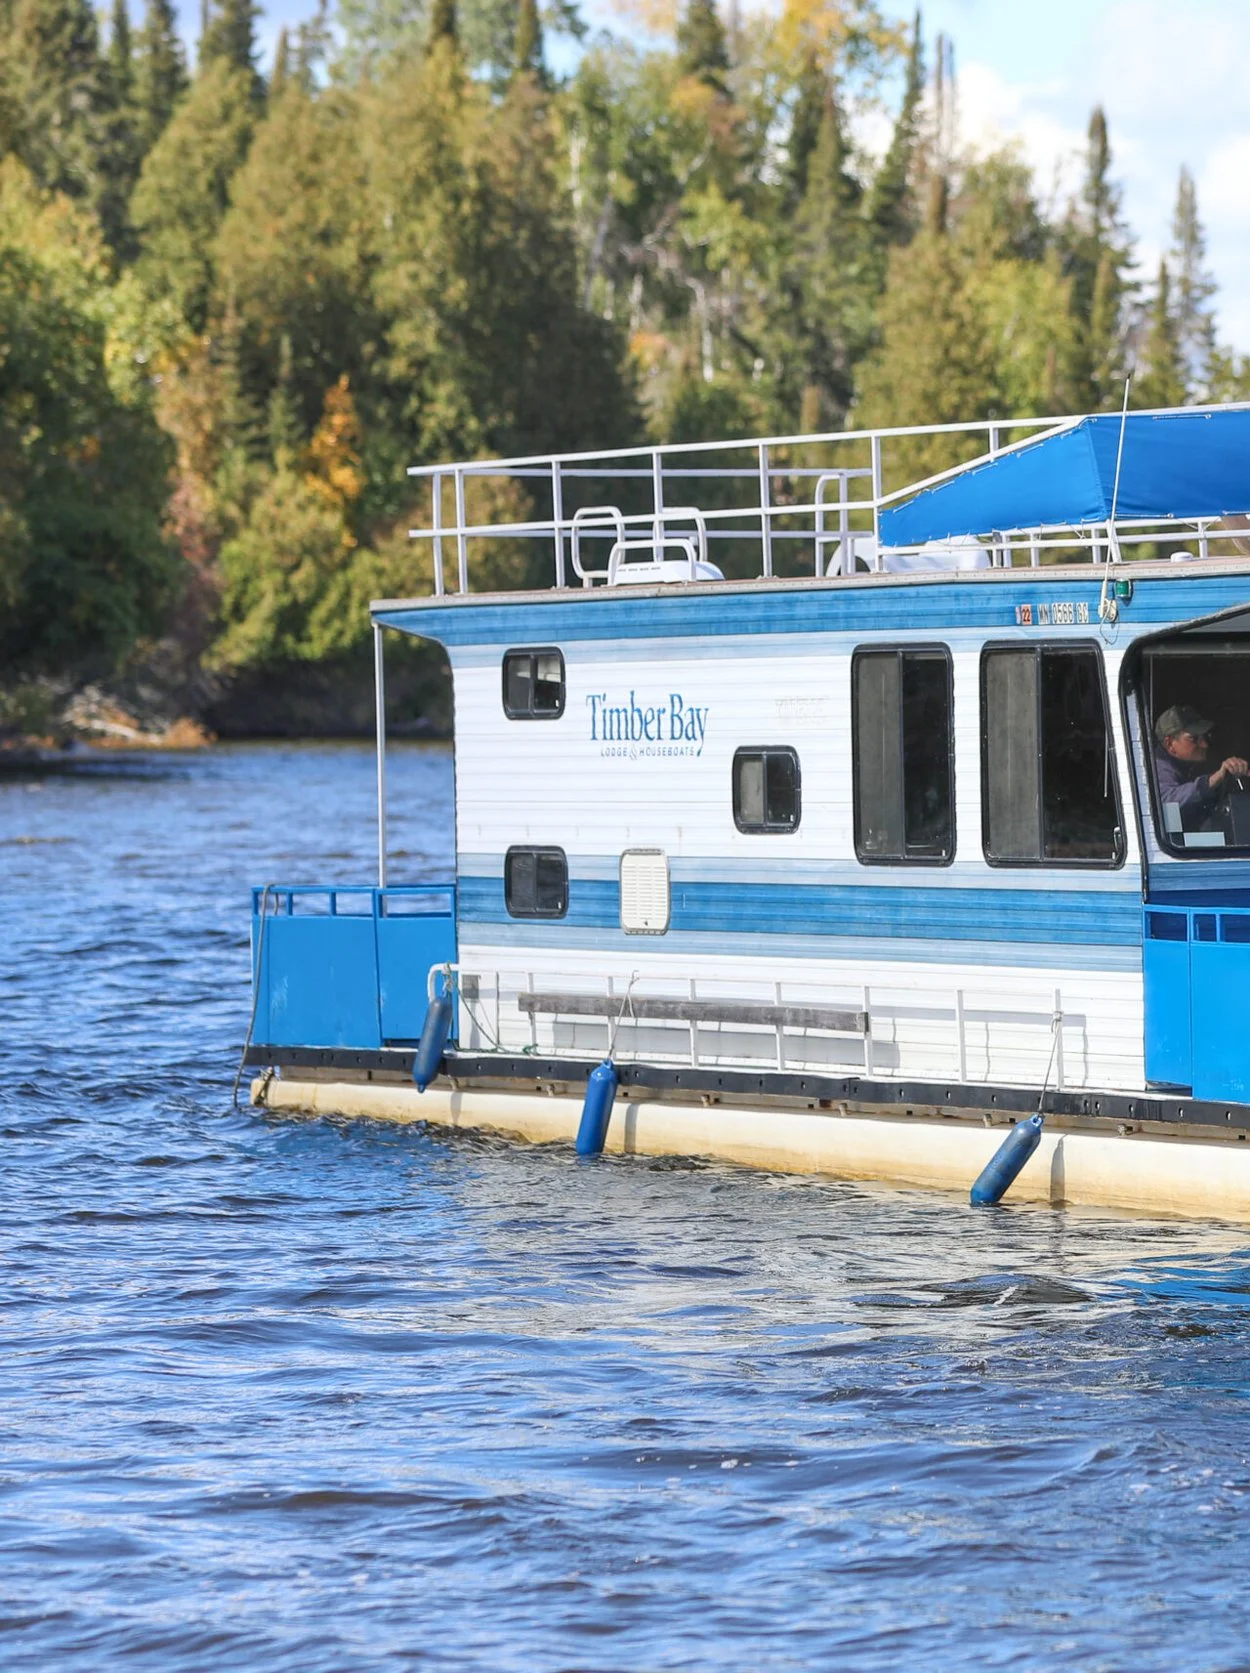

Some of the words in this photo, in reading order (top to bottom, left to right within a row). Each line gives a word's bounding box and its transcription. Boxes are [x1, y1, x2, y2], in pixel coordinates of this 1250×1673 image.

[1022, 608, 1031, 622] 22
[1052, 603, 1073, 623] 0566
[585, 689, 666, 742] Timber
[669, 693, 709, 757] Bay
[601, 747, 628, 757] LODGE
[639, 746, 695, 757] HOUSEBOATS
